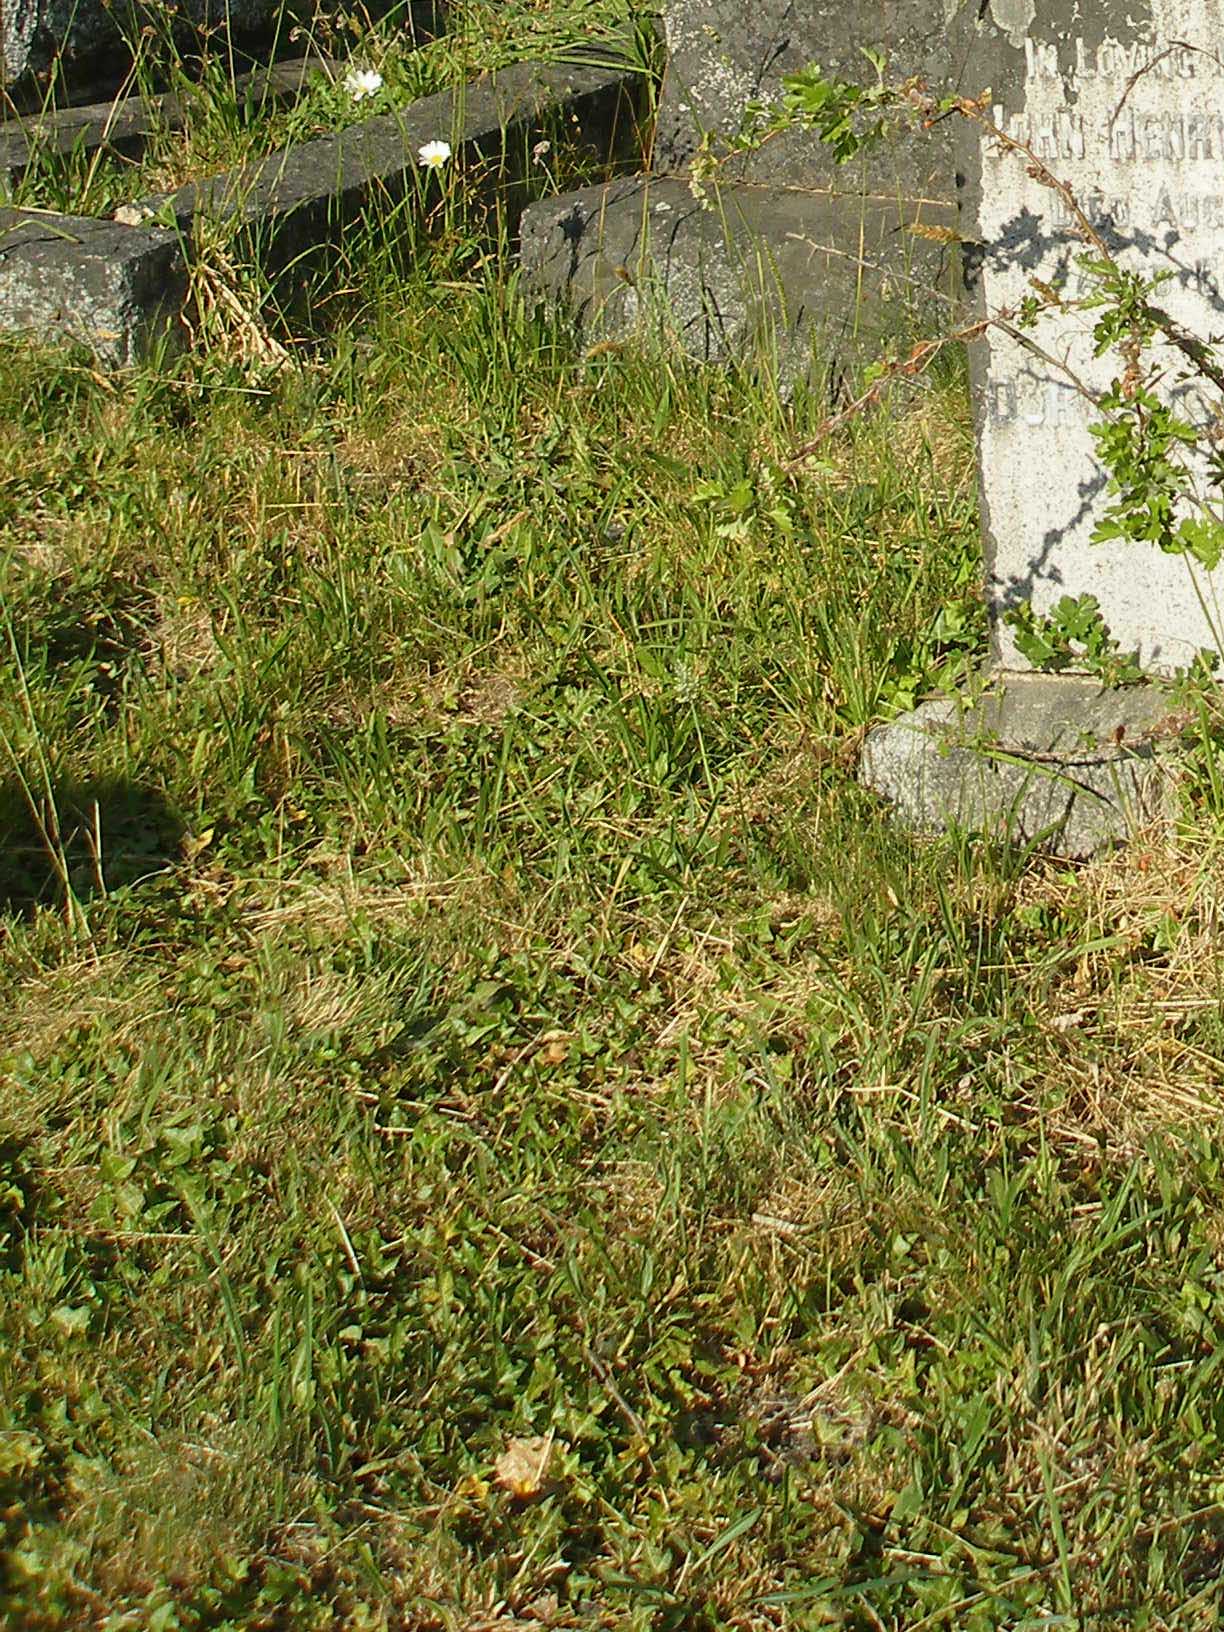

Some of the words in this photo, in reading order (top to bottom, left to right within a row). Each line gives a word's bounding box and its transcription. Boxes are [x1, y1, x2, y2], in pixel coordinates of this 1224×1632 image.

[1024, 36, 1059, 78] IN
[1073, 36, 1198, 79] LOVING
[979, 104, 1084, 160] JOHN
